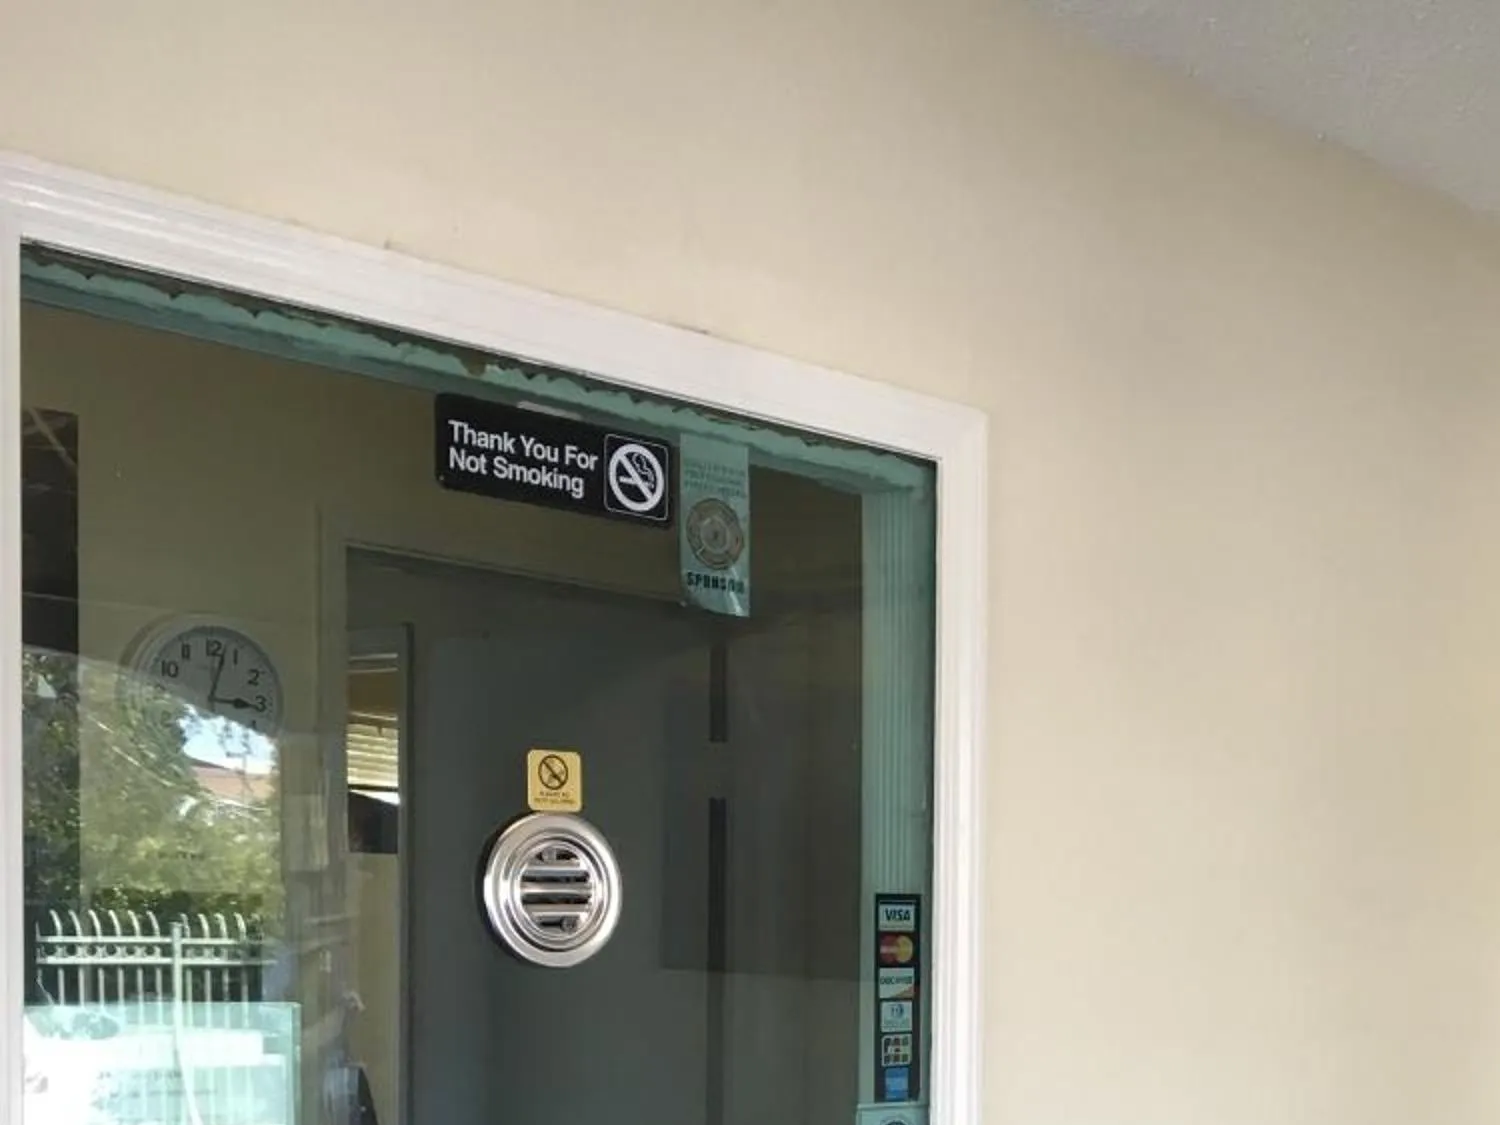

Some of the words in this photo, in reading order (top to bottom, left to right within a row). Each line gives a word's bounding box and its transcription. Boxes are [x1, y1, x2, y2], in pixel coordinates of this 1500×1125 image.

[448, 419, 516, 454] Thank
[520, 435, 559, 463] You
[564, 444, 599, 471] For
[449, 446, 488, 475] Not
[493, 456, 585, 499] Smoking
[206, 638, 223, 657] 12
[233, 648, 239, 665] 1
[161, 660, 179, 678] 10
[247, 669, 261, 686] 2
[254, 695, 268, 713] 3
[884, 908, 911, 921] VISA
